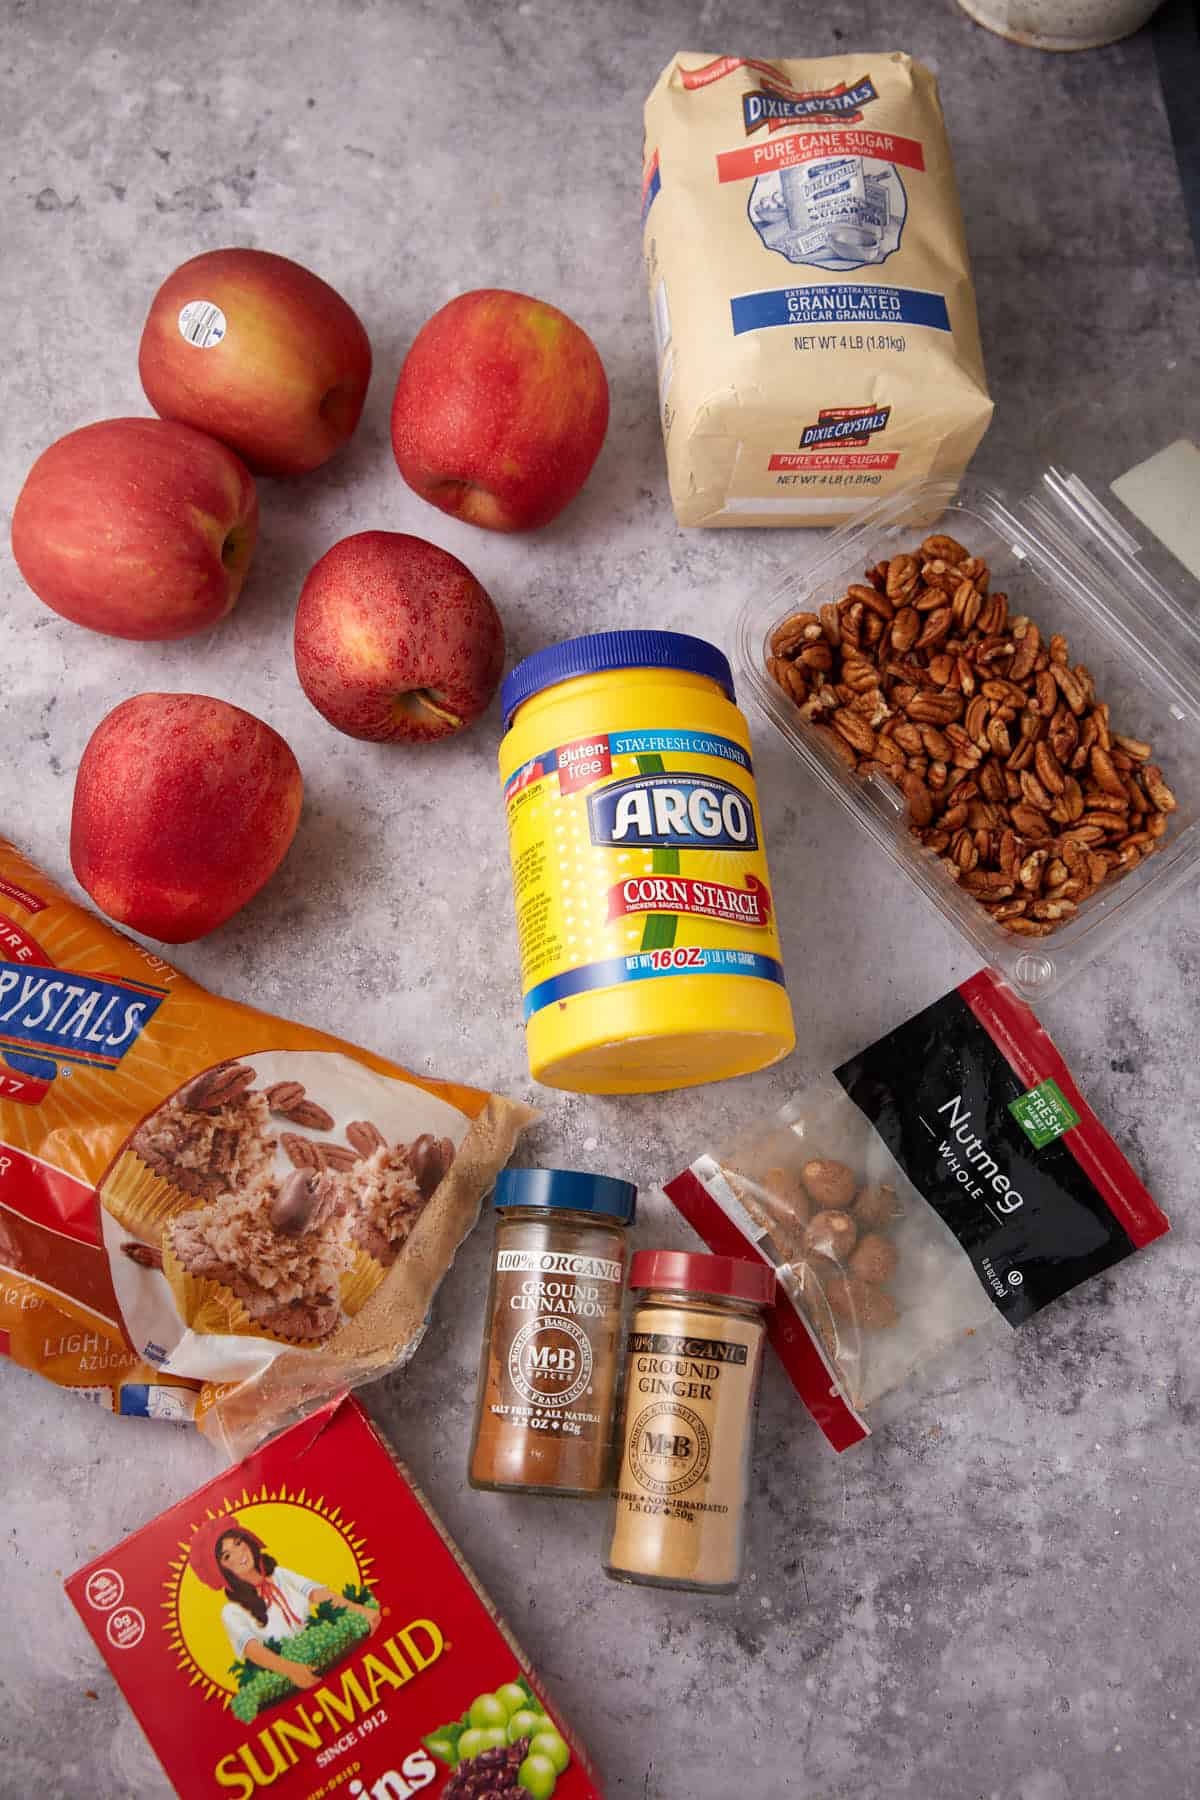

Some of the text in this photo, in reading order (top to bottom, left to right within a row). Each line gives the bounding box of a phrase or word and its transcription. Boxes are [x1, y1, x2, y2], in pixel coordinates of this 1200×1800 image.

[749, 95, 794, 121] DIXIE
[794, 87, 871, 115] CRYSTALS
[753, 133, 894, 164] PURE CANE SUGAR
[785, 288, 810, 298] EXTRA
[811, 286, 829, 296] FINE
[837, 287, 863, 295] EXTRA
[787, 294, 901, 313] GRANULATED
[788, 308, 903, 322] AZÚCAR GRANULADA
[794, 335, 906, 352] NET WT 4 LB (1.81kg)
[804, 413, 887, 444] DIXIE CRYSTALS
[780, 455, 889, 465] PURE CANE SUGAR
[776, 474, 799, 485] NET
[799, 474, 820, 485] WT
[558, 743, 609, 769] gluten-
[616, 737, 746, 767] STAY-FRESH CONTAINER
[567, 760, 602, 779] free
[611, 788, 749, 843] ARGO
[623, 879, 759, 916] CORN STARCH
[651, 950, 671, 969] 16
[1027, 1090, 1065, 1136] FRESH
[937, 1095, 1024, 1215] Nutmeg
[938, 1139, 985, 1200] WHOLE
[498, 1253, 622, 1282] 100% ORGANIC
[521, 1280, 599, 1301] GROUND
[510, 1295, 608, 1317] CINNAMON
[637, 1356, 720, 1380] GROUND
[531, 1381, 584, 1405] FRANCISCO
[638, 1377, 712, 1401] GINGER
[543, 1409, 563, 1419] ALL
[530, 1418, 549, 1430] OZ
[562, 1421, 582, 1436] 62g
[647, 1495, 729, 1514] NON-IRRADIATED
[316, 1708, 389, 1769] SINCE 1912
